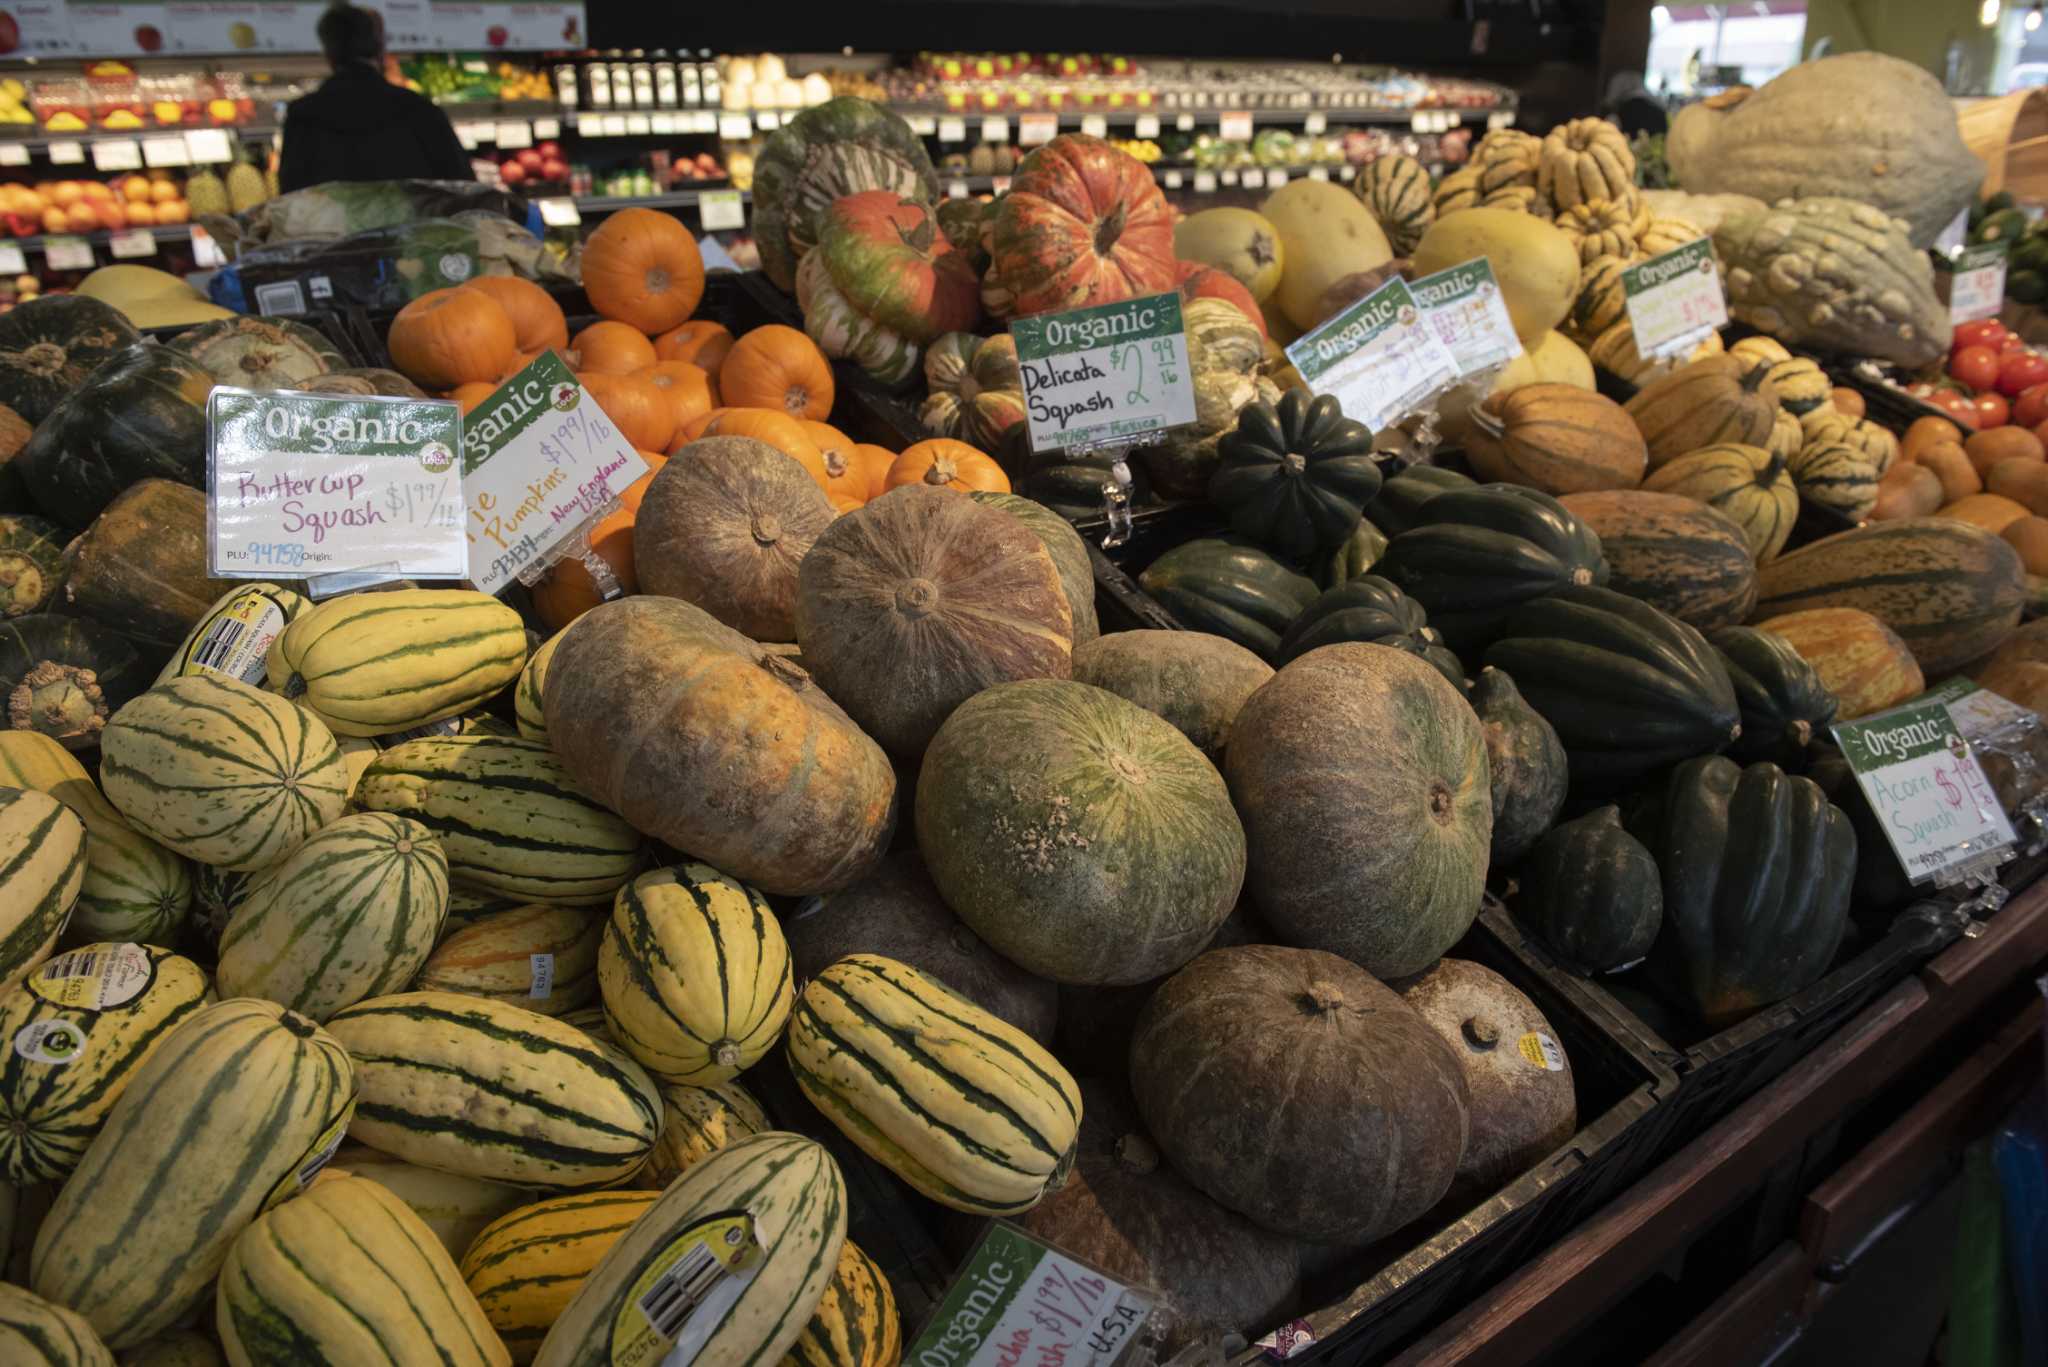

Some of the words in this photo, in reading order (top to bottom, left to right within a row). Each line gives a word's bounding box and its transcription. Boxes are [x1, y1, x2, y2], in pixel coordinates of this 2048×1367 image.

[1639, 249, 1699, 285] Organic
[1418, 272, 1475, 309] ganic
[1046, 304, 1155, 350] Organic
[1316, 297, 1394, 361] Organic
[1020, 357, 1106, 395] Delicata
[265, 406, 421, 451] Organic
[464, 380, 545, 463] ganic
[1029, 390, 1114, 430] Squash
[283, 500, 387, 544] Squash
[466, 491, 497, 543] ie
[484, 467, 568, 550] Pumpkins
[226, 551, 249, 561] PLU:
[1864, 714, 1943, 760] Organic
[1871, 773, 1935, 809] Acorn
[1892, 799, 1959, 845] Squash
[920, 1262, 1013, 1367] Organic
